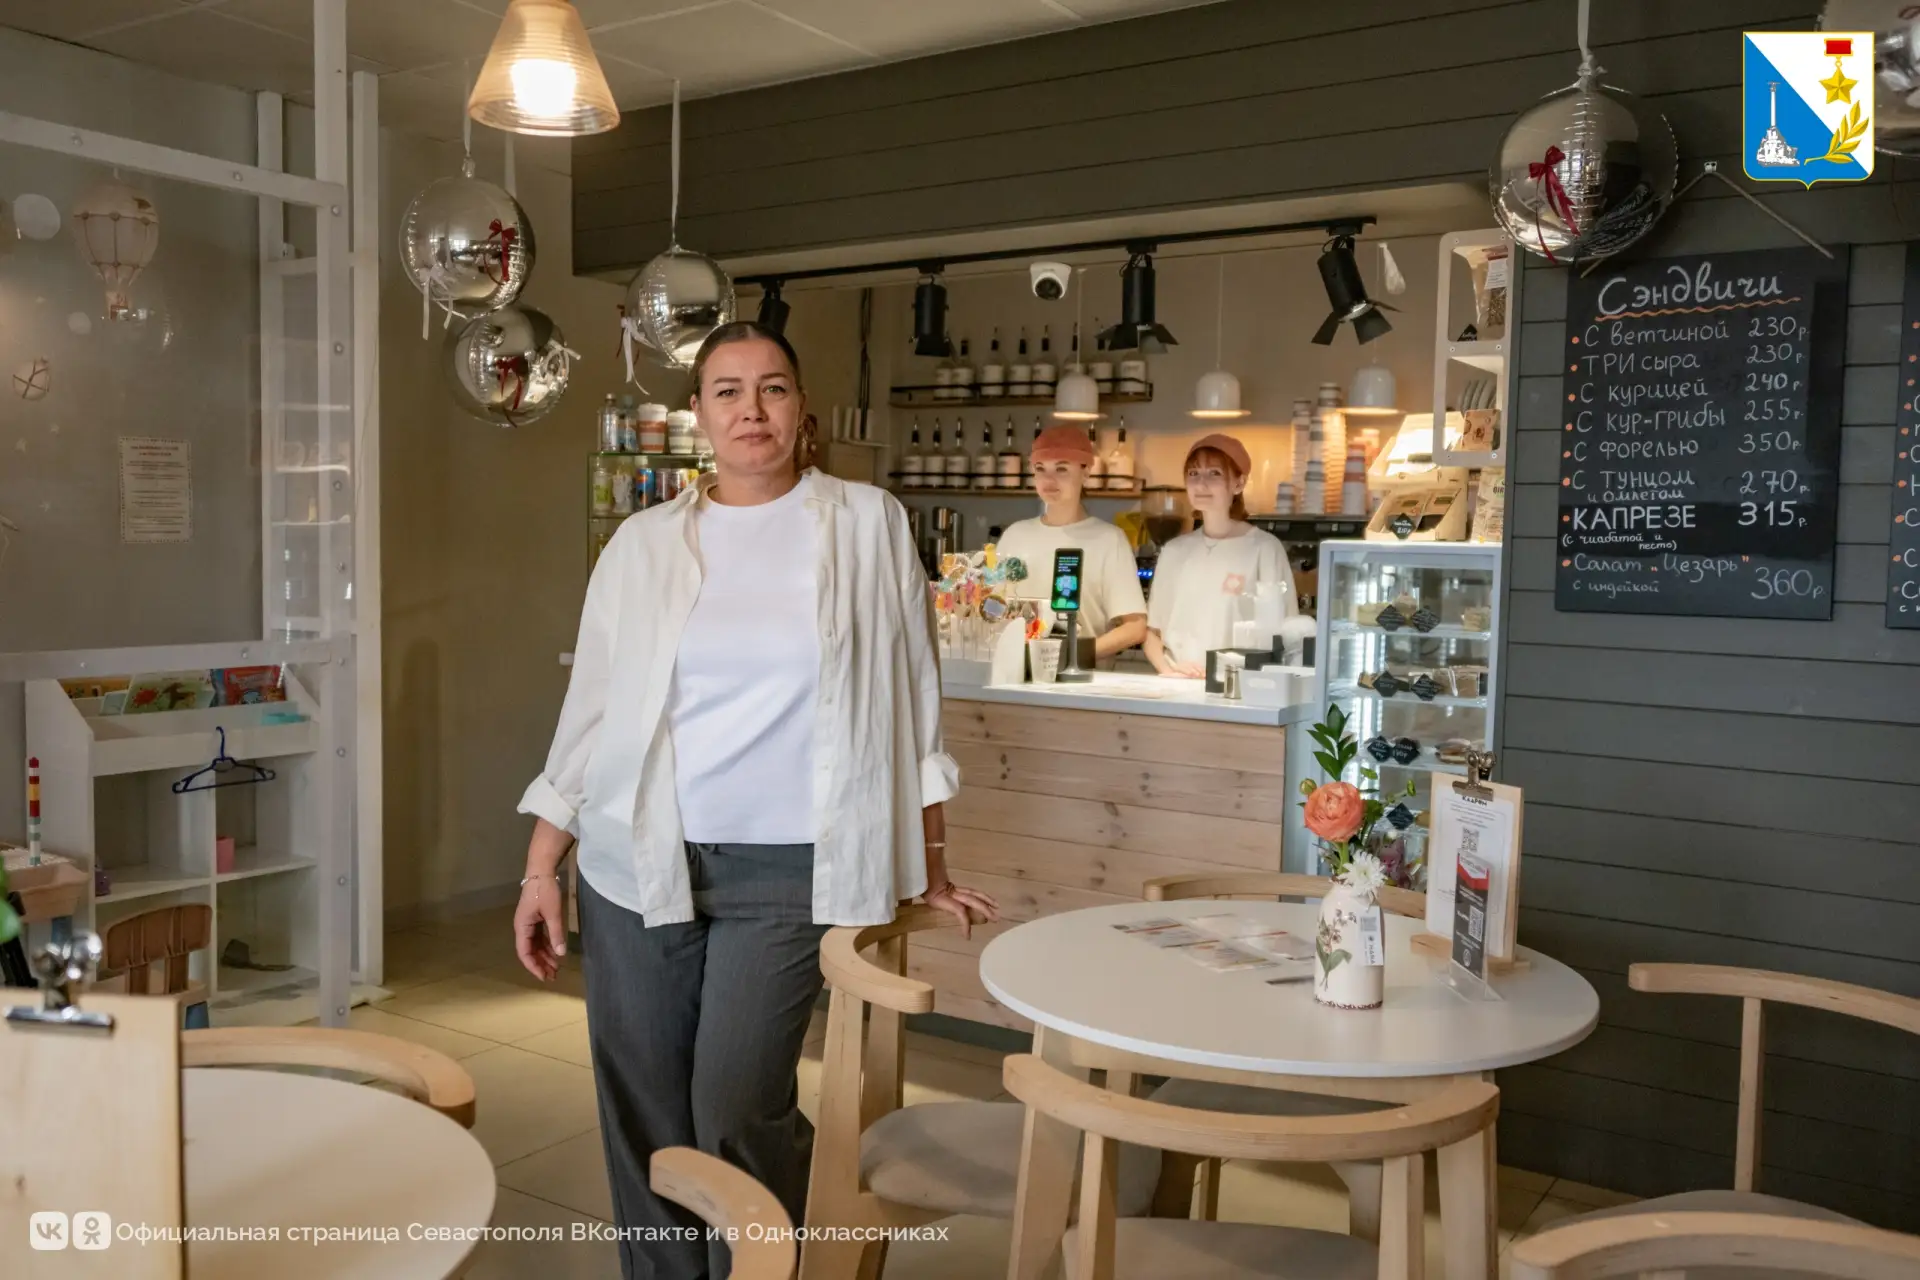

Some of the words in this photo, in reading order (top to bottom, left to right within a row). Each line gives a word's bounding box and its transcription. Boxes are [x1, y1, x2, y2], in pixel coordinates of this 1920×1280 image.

[1598, 261, 1783, 315] Сэндвичи
[1584, 324, 1600, 347] С
[1610, 320, 1730, 346] ветчиной
[1581, 353, 1635, 376] ТРИ
[1641, 353, 1701, 377] сыра
[1580, 382, 1595, 403] С
[1608, 379, 1709, 407] курицей
[1576, 410, 1593, 433] С
[1573, 441, 1588, 462] С
[1572, 469, 1587, 490] С
[1603, 488, 1685, 502] омлетом
[1573, 504, 1697, 530] КАПРЕЗЕ
[1574, 552, 1642, 572] Салат
